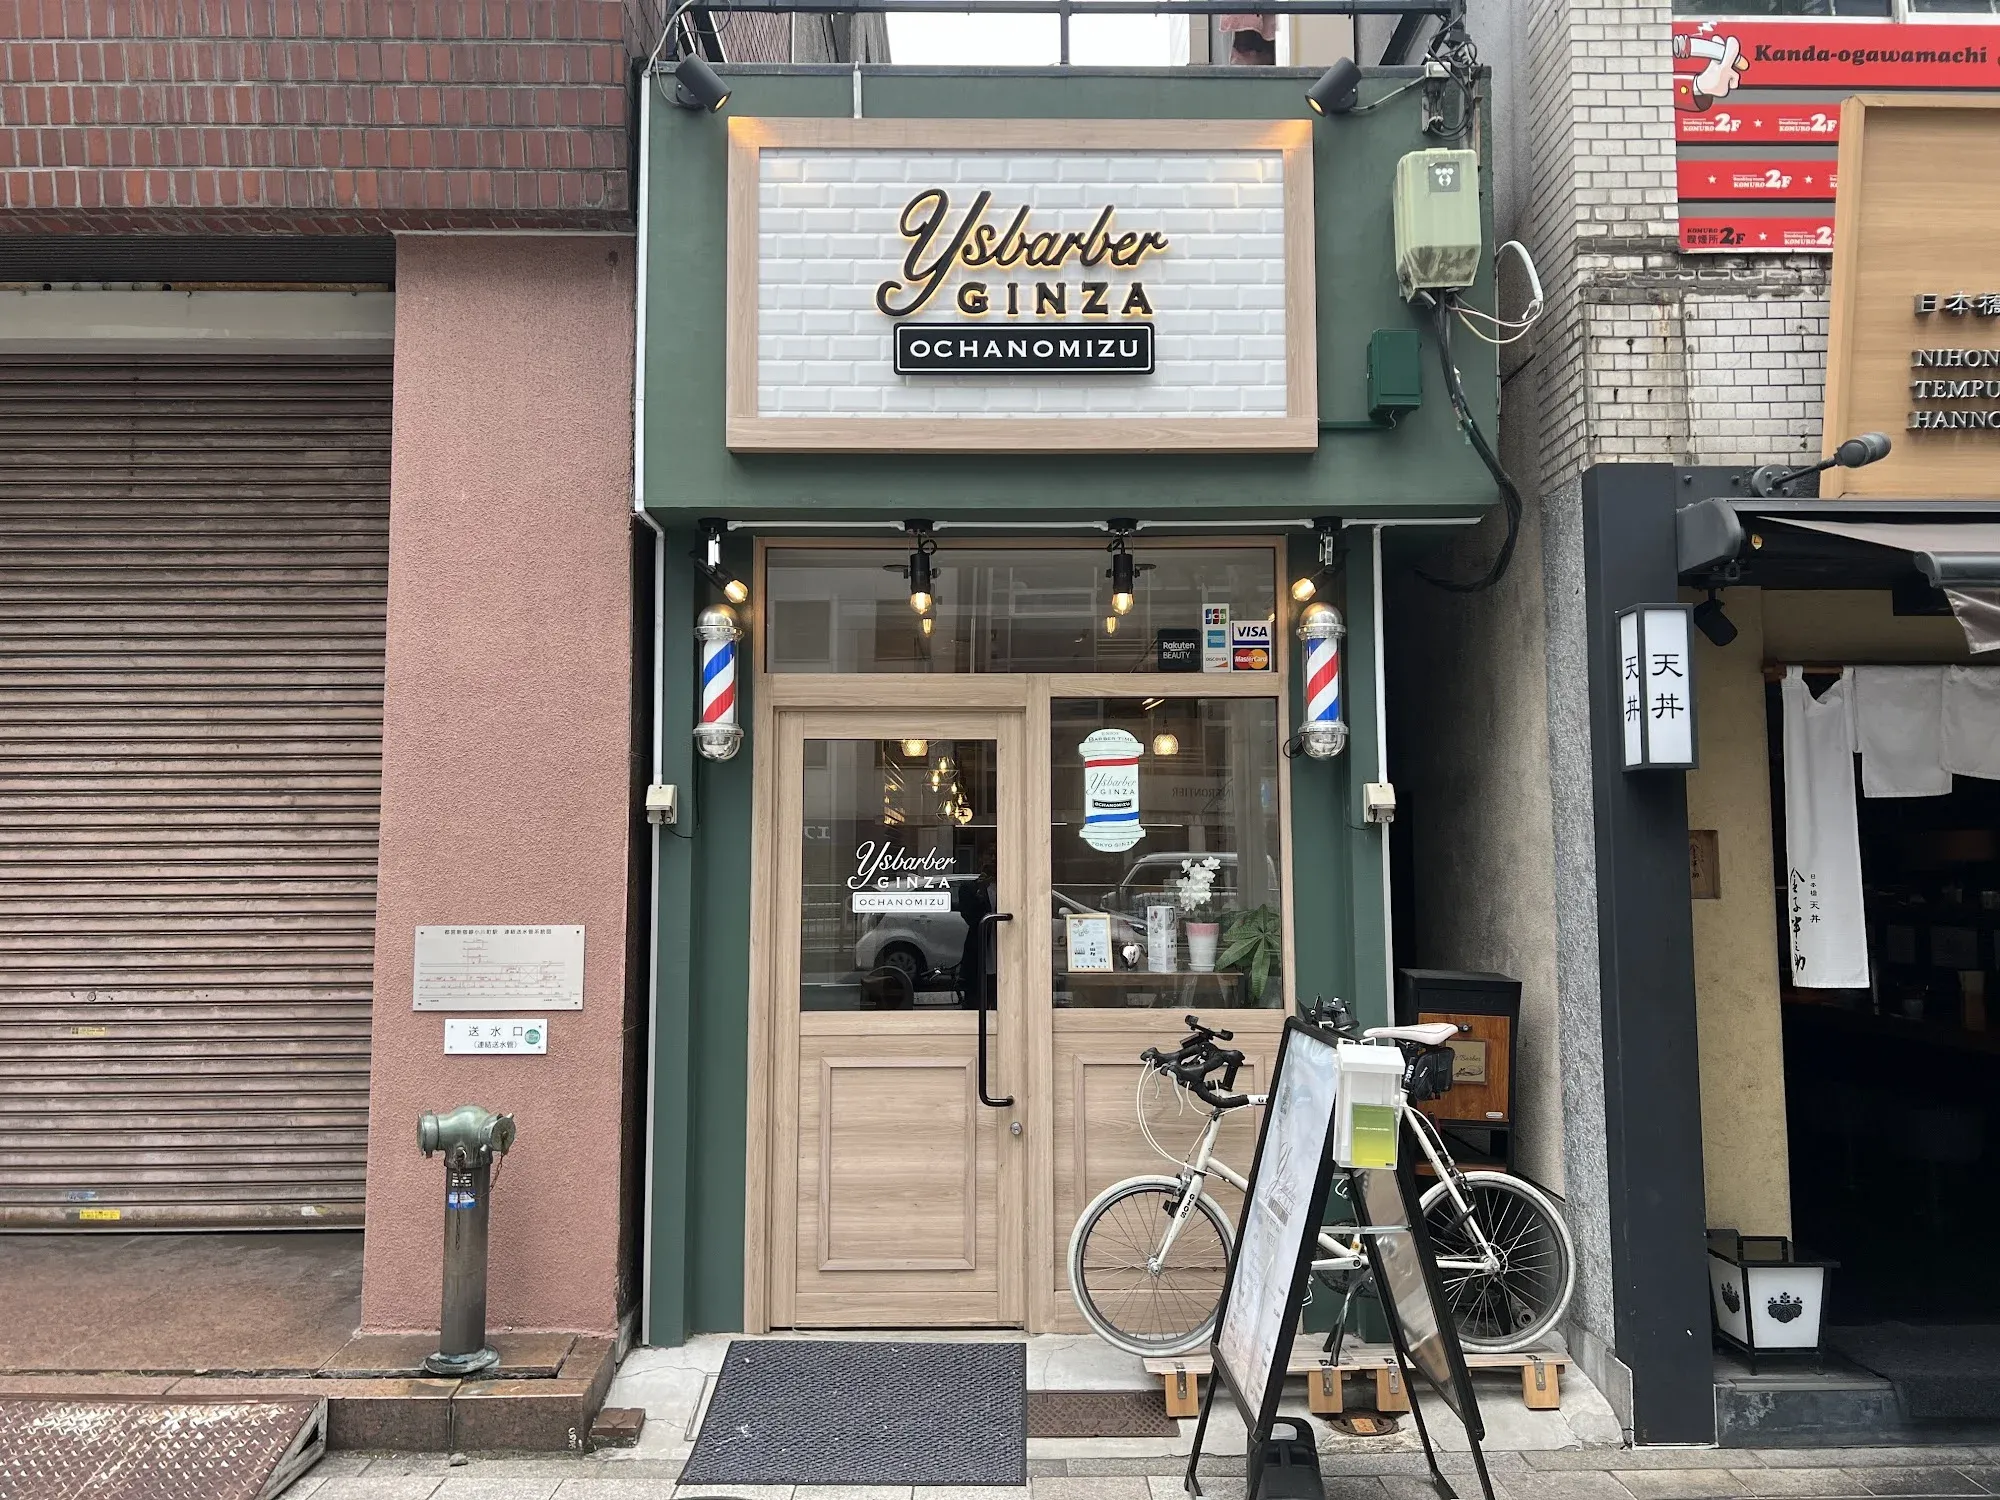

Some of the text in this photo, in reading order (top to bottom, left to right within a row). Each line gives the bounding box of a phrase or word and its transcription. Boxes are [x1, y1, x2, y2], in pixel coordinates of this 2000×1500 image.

[1754, 44, 1987, 66] Kanda-ogawamachi
[1715, 113, 1741, 132] 2F
[1811, 114, 1837, 133] 2F
[1765, 169, 1791, 189] 2F
[1720, 227, 1746, 245] 2F
[1816, 226, 1835, 246] 2
[876, 188, 1169, 316] Ysbarber
[957, 281, 1153, 315] GINZA
[909, 340, 1138, 358] OCHANOMIZU
[1913, 349, 2000, 368] NIHON
[1206, 611, 1226, 622] JCB
[1238, 626, 1268, 637] VISA
[1163, 642, 1195, 651] Rakuten
[1626, 656, 1640, 722] 天丼
[1651, 654, 1684, 719] 天丼
[847, 841, 957, 889] Ysbarber
[878, 876, 950, 889] GINZA
[468, 1026, 523, 1037] 送水口
[1180, 1194, 1195, 1218] GIOS
